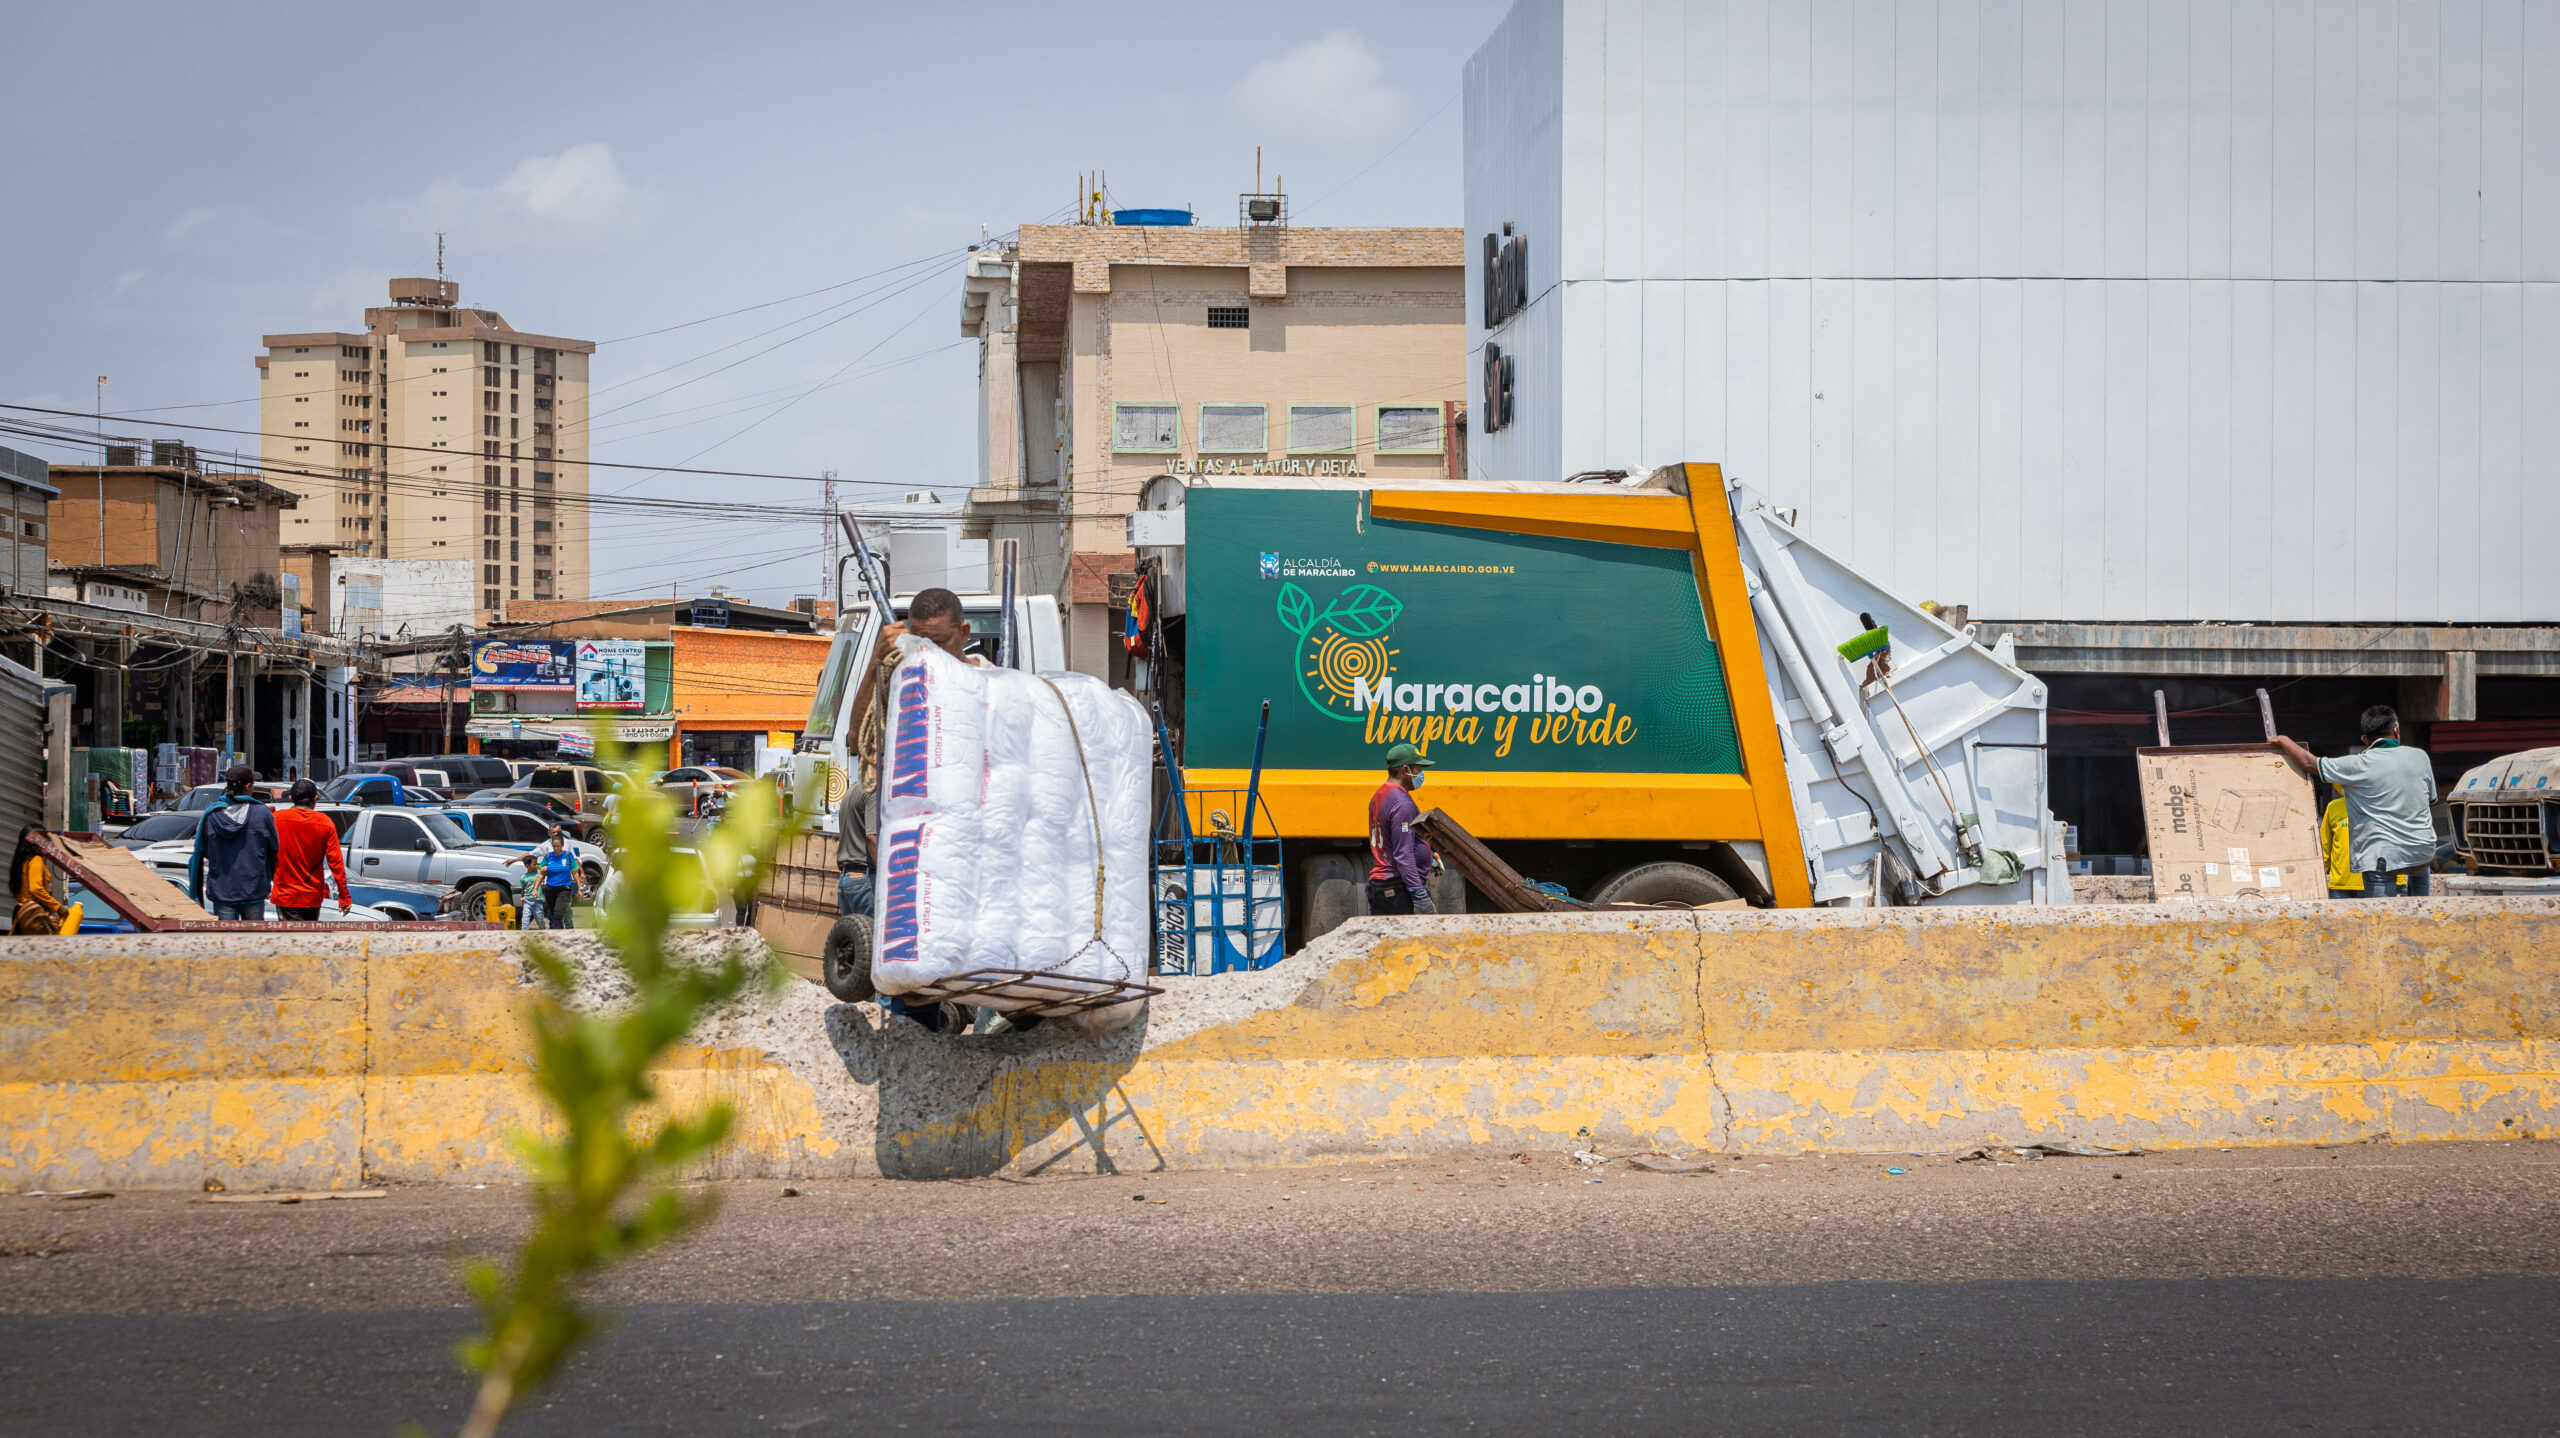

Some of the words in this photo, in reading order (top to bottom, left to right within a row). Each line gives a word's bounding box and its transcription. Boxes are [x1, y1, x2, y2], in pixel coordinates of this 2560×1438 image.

[1166, 458, 1224, 474] VENTAS
[1228, 459, 1247, 474] AL
[1252, 459, 1300, 474] MAYOR
[1305, 459, 1317, 475] Y
[1321, 459, 1366, 474] DETAL
[1283, 557, 1341, 568] ALCALDÍA
[1283, 568, 1296, 577] DE
[1298, 568, 1356, 577] MARACAIBO
[1380, 564, 1515, 574] WWW.MARACAIBO.GOB.VE
[1353, 673, 1603, 713] Maracaibo
[891, 660, 929, 799] TOMMY
[934, 705, 942, 769] ANTIALERGICA
[1364, 701, 1484, 757] limpia
[1494, 714, 1519, 757] y
[1530, 703, 1638, 746] verde
[2163, 784, 2187, 834] mabe
[883, 822, 926, 963] TOMMY
[2175, 872, 2193, 894] be
[1166, 901, 1185, 973] CORONET
